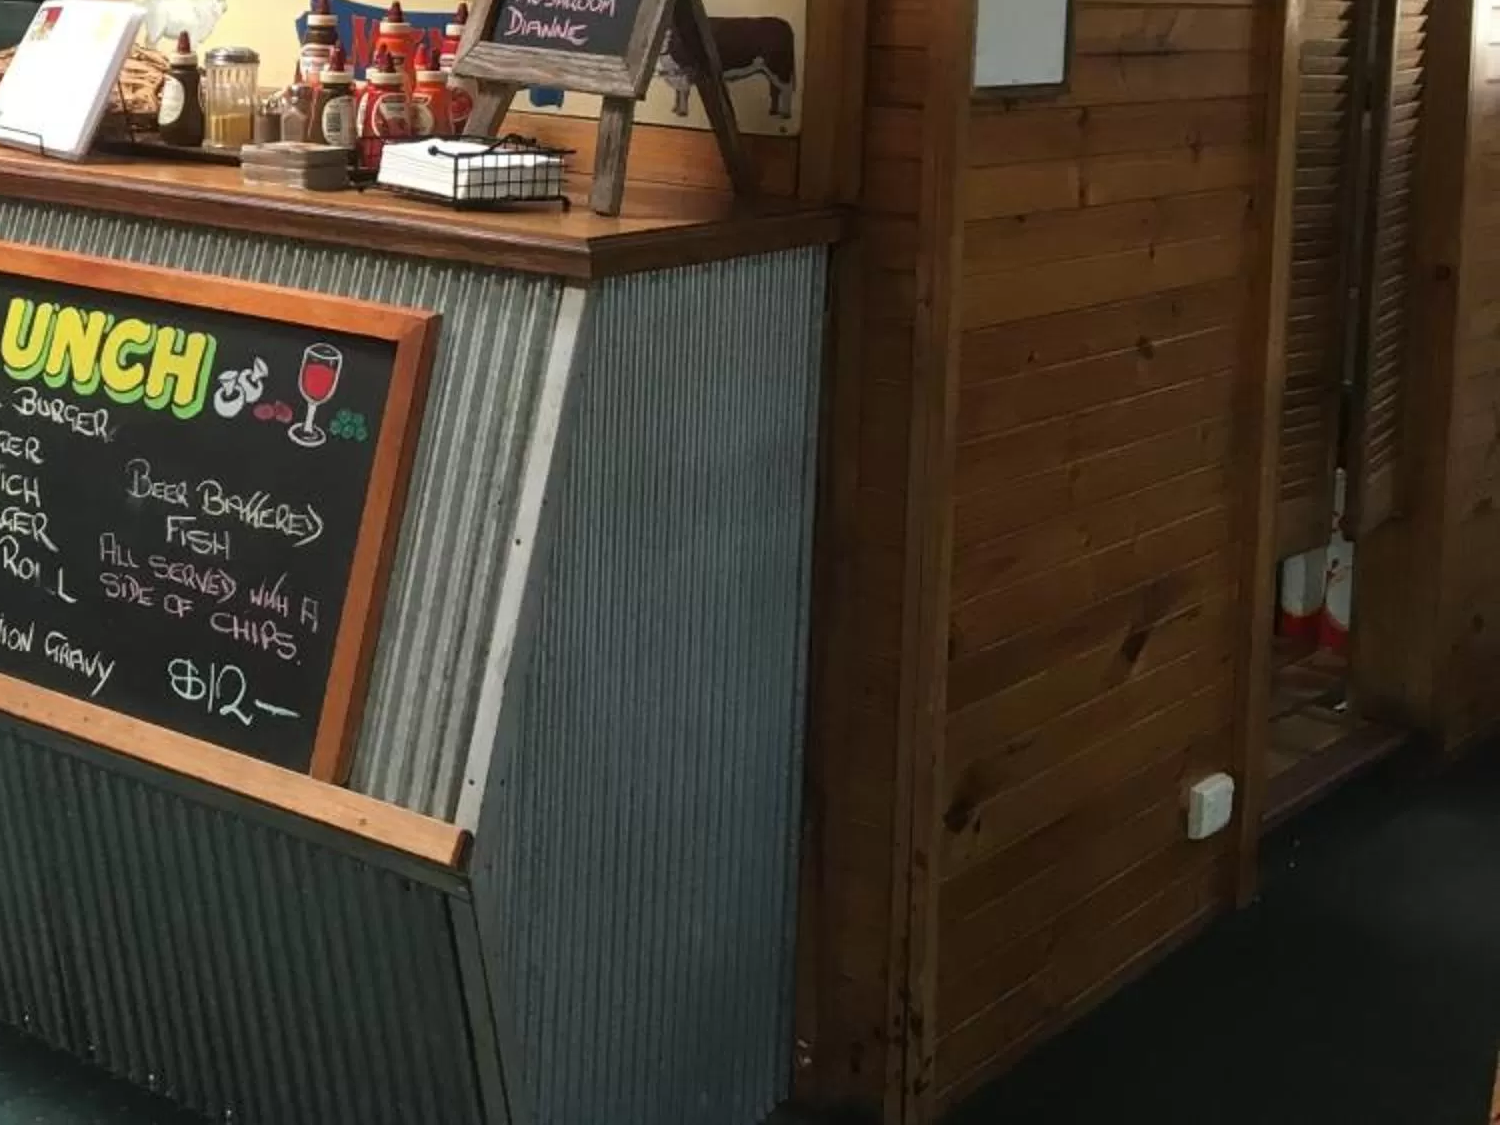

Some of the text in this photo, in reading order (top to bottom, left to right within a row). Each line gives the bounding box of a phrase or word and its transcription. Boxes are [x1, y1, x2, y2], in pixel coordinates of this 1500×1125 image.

[505, 6, 588, 46] DIANNE
[12, 386, 112, 442] BURGER
[125, 458, 325, 547] BEER BATTERED
[166, 515, 230, 560] FISH
[100, 532, 319, 634] ALL SERVED WITH A
[100, 573, 154, 607] SIDE
[164, 594, 193, 618] OF
[44, 630, 116, 697] GRAVY
